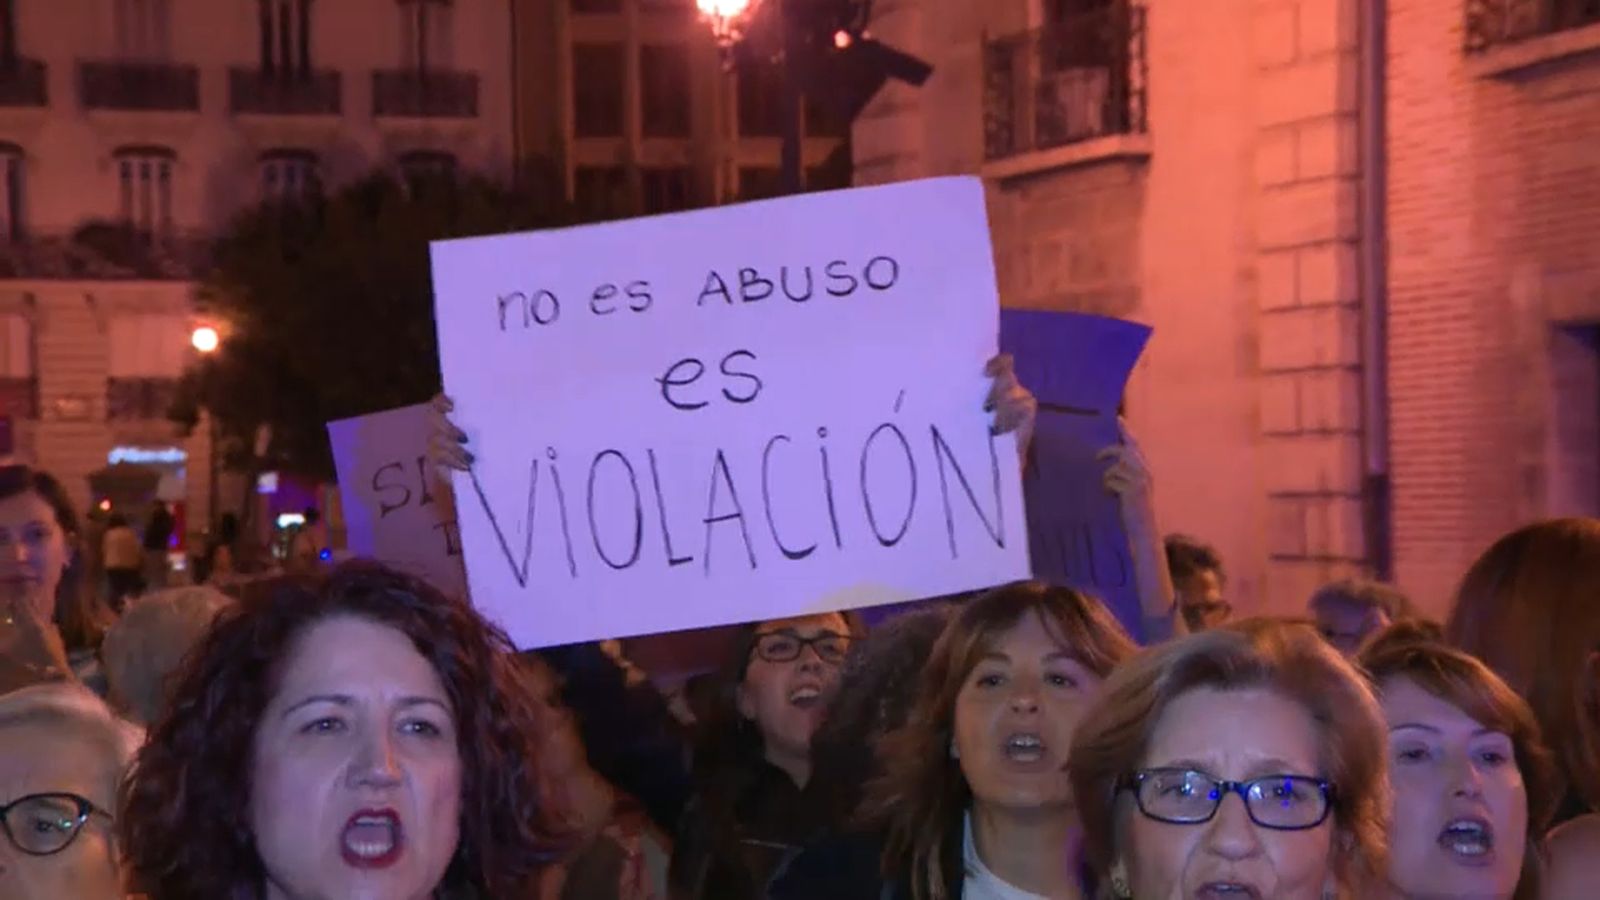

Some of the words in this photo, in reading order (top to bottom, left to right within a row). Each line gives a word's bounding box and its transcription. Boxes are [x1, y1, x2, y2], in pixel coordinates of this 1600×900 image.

[590, 280, 653, 315] es
[697, 255, 899, 306] ABUSO
[655, 350, 763, 410] es
